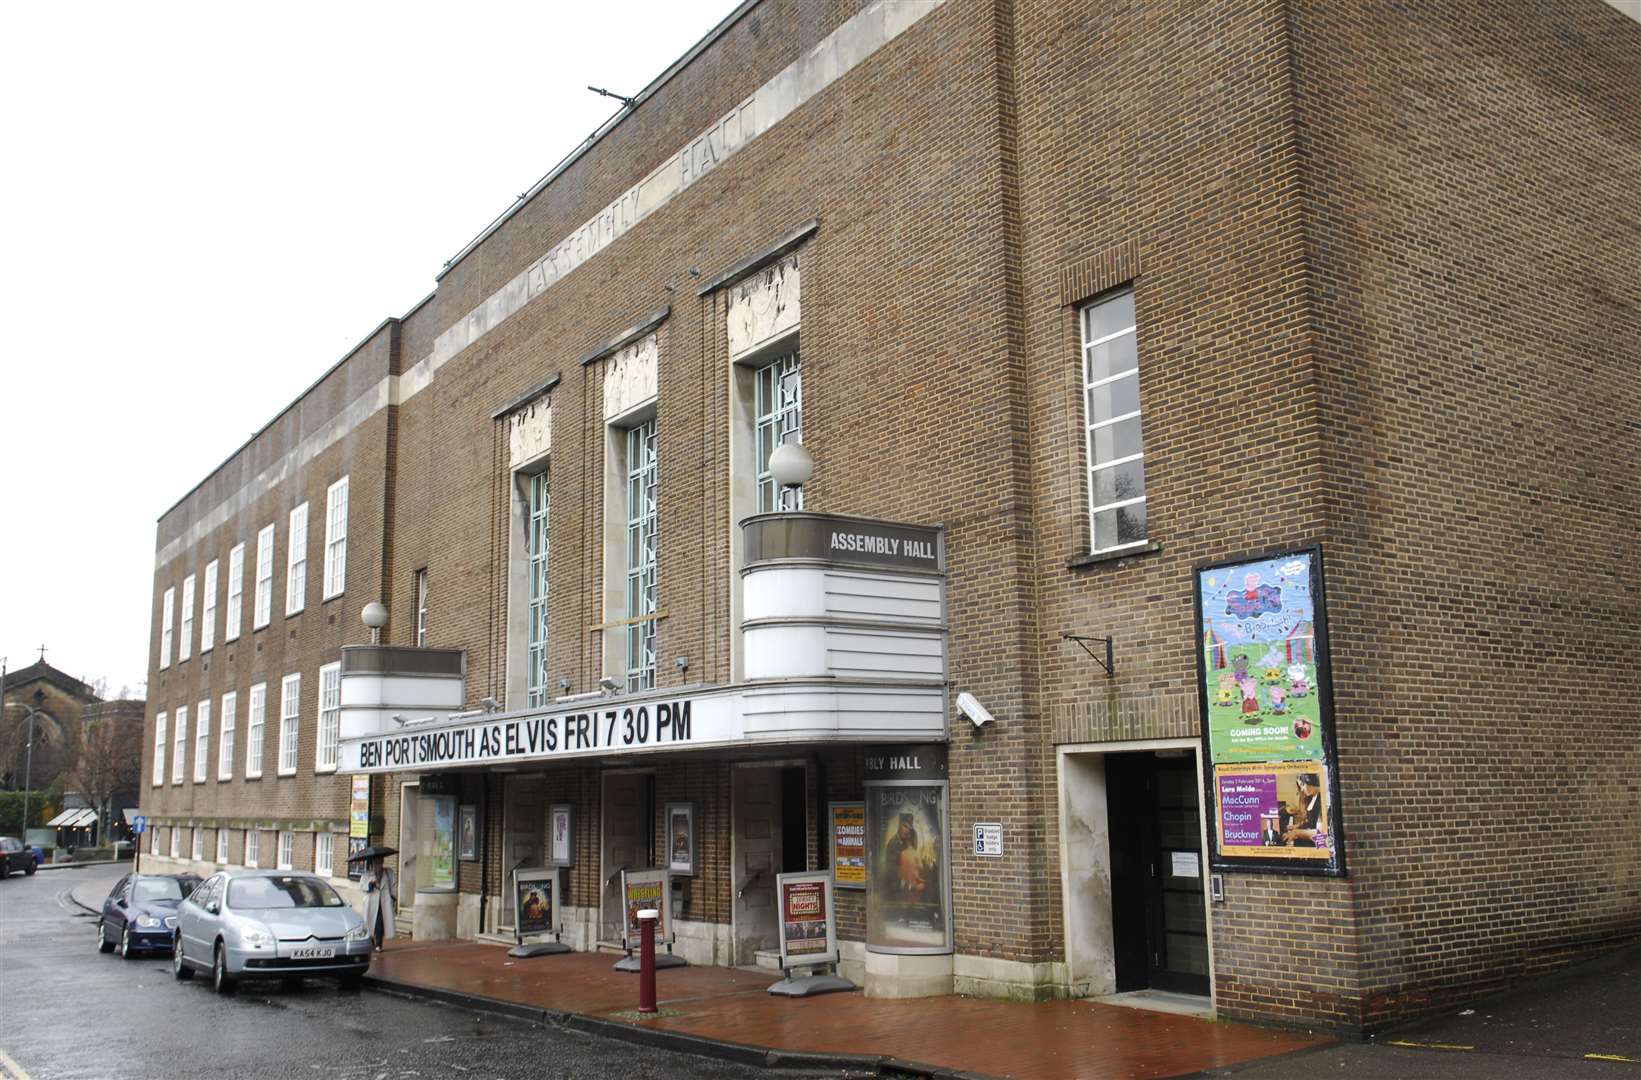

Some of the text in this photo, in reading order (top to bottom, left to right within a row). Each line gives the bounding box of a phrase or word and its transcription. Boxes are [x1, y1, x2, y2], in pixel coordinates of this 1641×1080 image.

[533, 101, 756, 294] ASSEMBLY HALL
[830, 531, 936, 559] ASSEMBLY HALL
[360, 700, 692, 768] BEN PORTSMOUTH AS ELVIS FRI 7 30 PM
[1230, 727, 1262, 737] COMING
[890, 755, 922, 770] HALL
[1222, 795, 1260, 805] MacCunn
[1223, 811, 1252, 823] Chopin
[1224, 829, 1259, 840] Bruckner
[792, 902, 818, 911] NIGHTS
